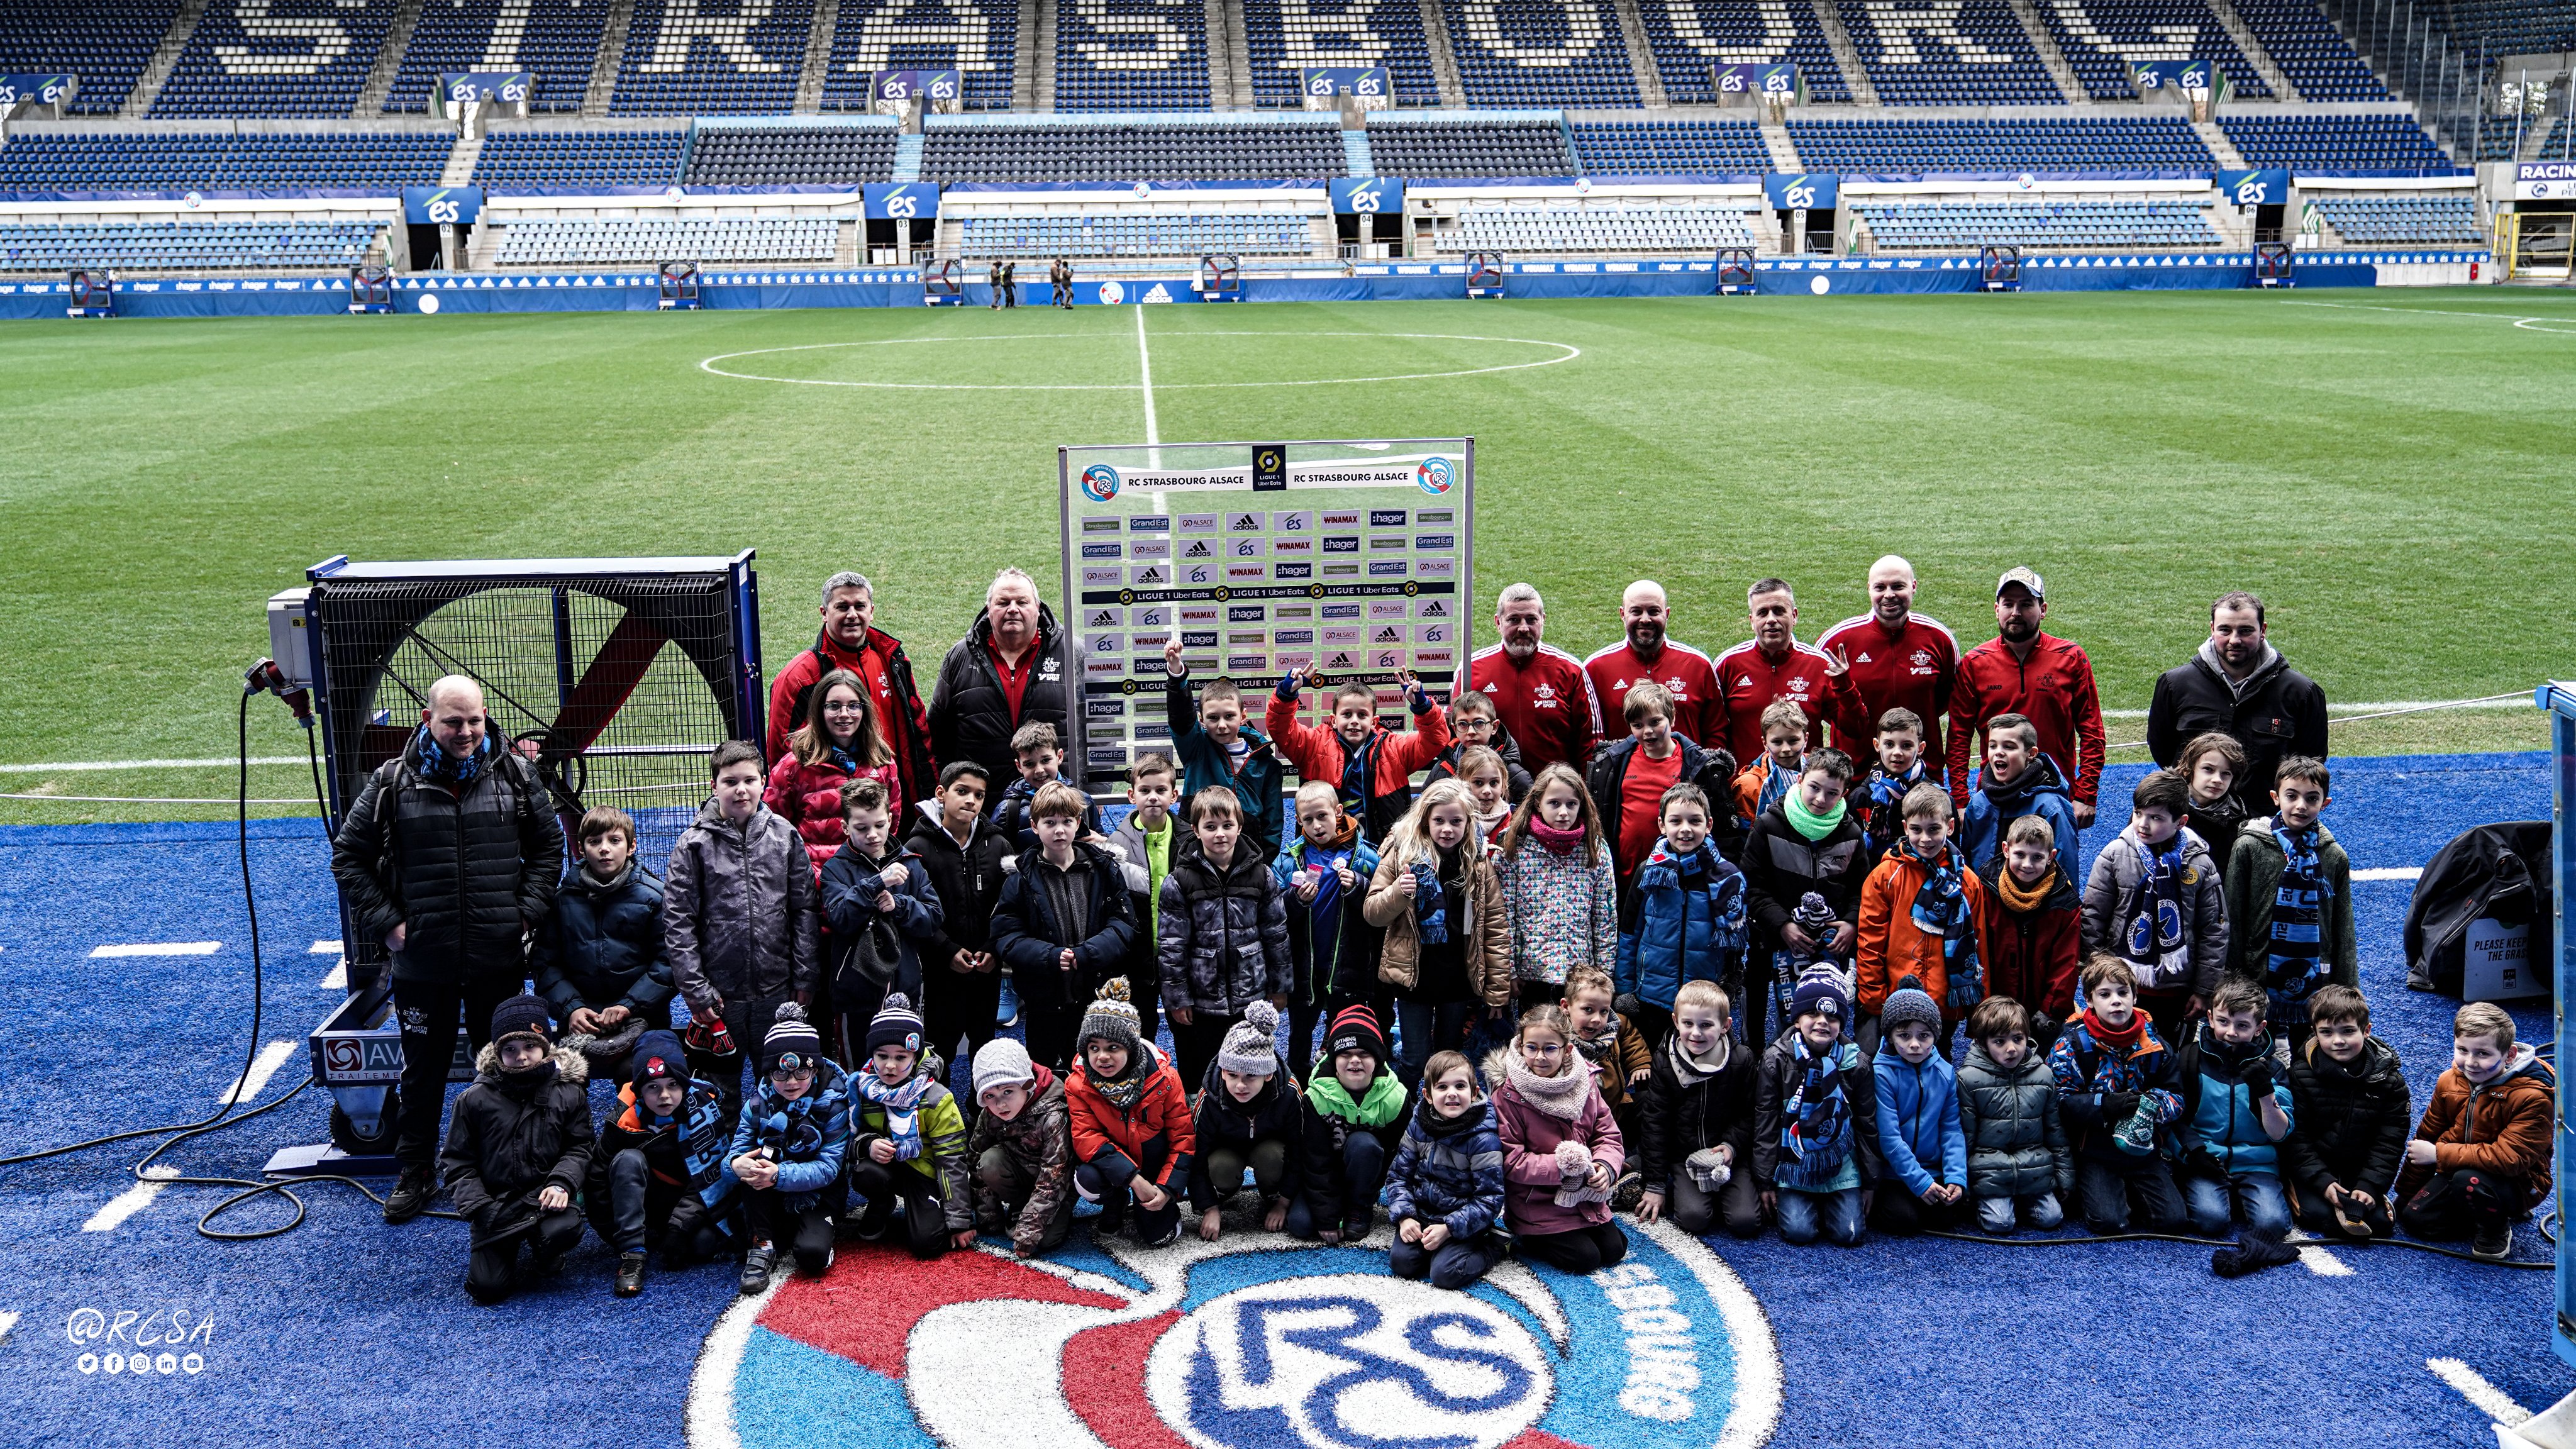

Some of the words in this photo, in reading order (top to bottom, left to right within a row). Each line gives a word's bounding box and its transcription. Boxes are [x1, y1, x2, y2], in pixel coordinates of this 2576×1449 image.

[1796, 211, 1804, 219] 05
[898, 220, 908, 228] 03
[1143, 477, 1206, 486] STRASBOURG
[1209, 476, 1244, 484] ALSACE
[1294, 474, 1306, 482] RC
[1309, 474, 1372, 482] STRASBOURG
[1374, 472, 1408, 480] ALSACE
[1324, 516, 1357, 524] WINAMAX
[1277, 541, 1310, 550] WINAMAX
[1229, 568, 1263, 576] WINAMAX
[1135, 637, 1169, 645] WINAMAX
[2474, 939, 2505, 951] PLEASE
[2507, 937, 2527, 948] KEEP
[2488, 950, 2503, 962] THE
[2505, 948, 2527, 960] GRAS
